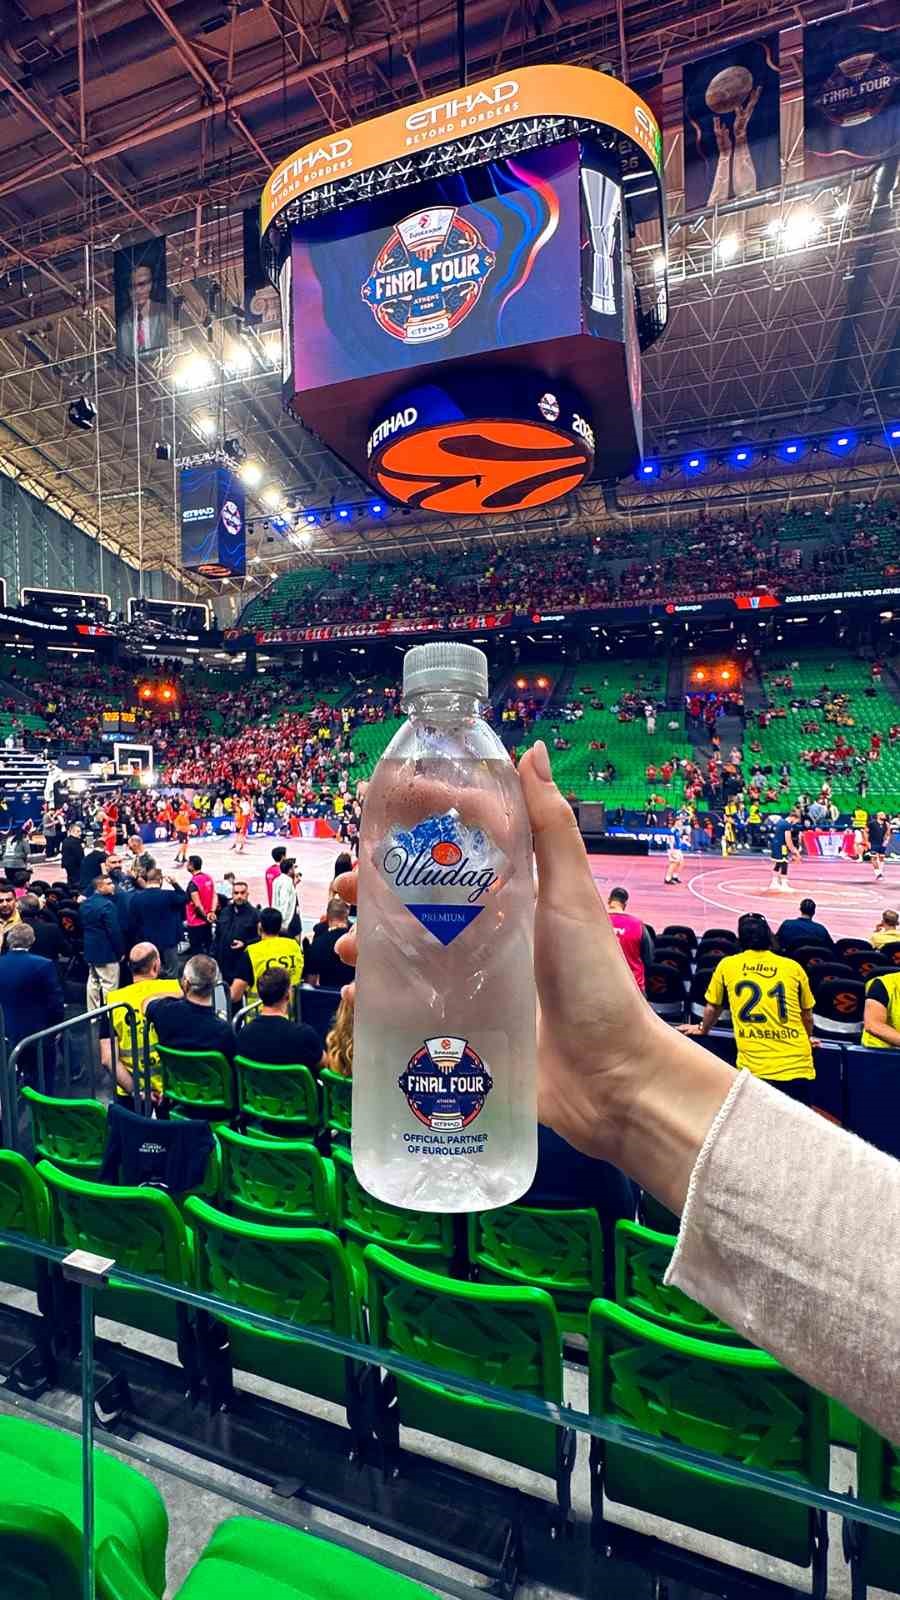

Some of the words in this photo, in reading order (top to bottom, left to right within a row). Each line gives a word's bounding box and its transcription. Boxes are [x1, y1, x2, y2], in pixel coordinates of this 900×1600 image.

[860, 76, 891, 95] FOUR
[405, 80, 520, 131] ETIHAD
[405, 123, 455, 146] BEYOND
[460, 101, 520, 128] BORDERS
[271, 138, 353, 195] ETIHAD
[303, 158, 353, 183] BORDERS
[430, 253, 481, 286] FOUR
[372, 407, 418, 447] ETIHAD
[383, 846, 498, 903] Uludağ
[734, 979, 788, 1025] 21
[450, 1076, 485, 1093] FOUR
[403, 1132, 446, 1145] OFFICIAL
[447, 1132, 489, 1144] PARTNER
[407, 1144, 421, 1154] OF
[422, 1144, 485, 1156] EUROLEAGUE
